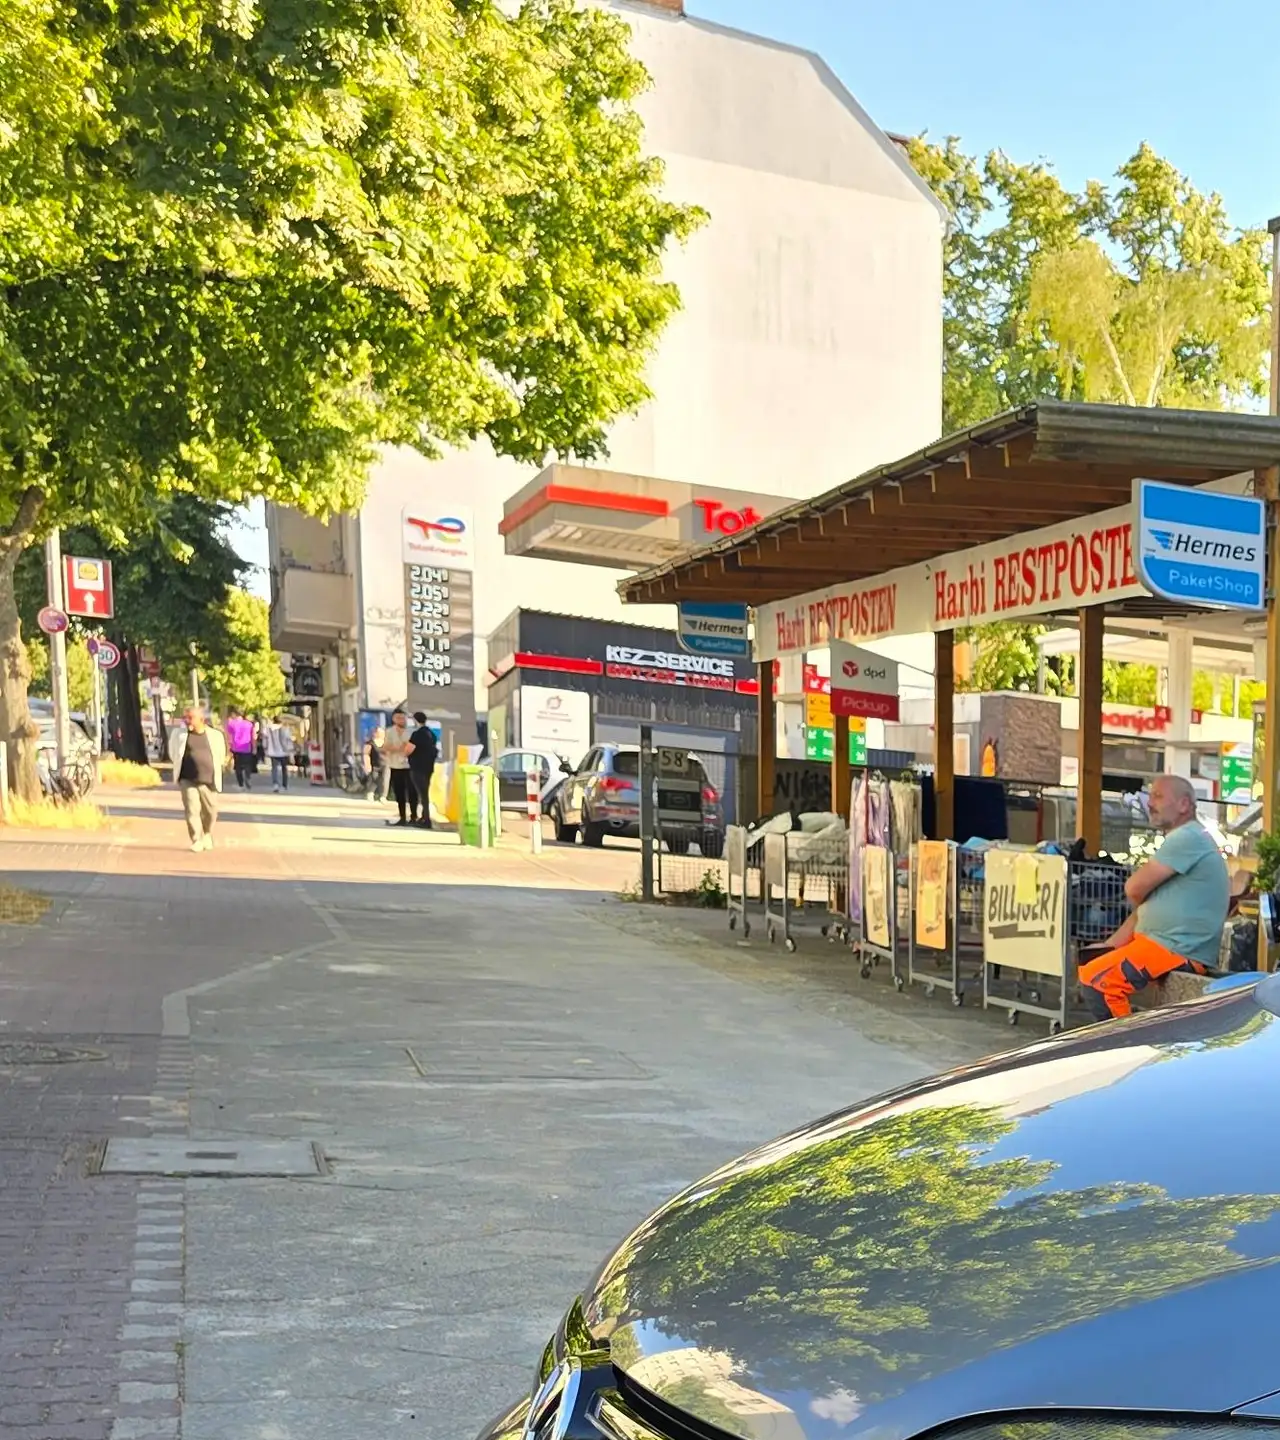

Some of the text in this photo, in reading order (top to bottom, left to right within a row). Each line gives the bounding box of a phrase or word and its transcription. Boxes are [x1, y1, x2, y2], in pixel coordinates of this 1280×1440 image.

[694, 498, 764, 535] Tot
[1175, 533, 1256, 562] Hermes
[934, 523, 1139, 621] Harbi RESTPOSTE
[1168, 569, 1254, 596] PaketShop
[698, 620, 744, 635] Hermes
[776, 583, 897, 650] Harbi RESTPOSTEN
[655, 651, 734, 677] SERVICE
[863, 664, 886, 682] dpd
[661, 751, 684, 767] 58
